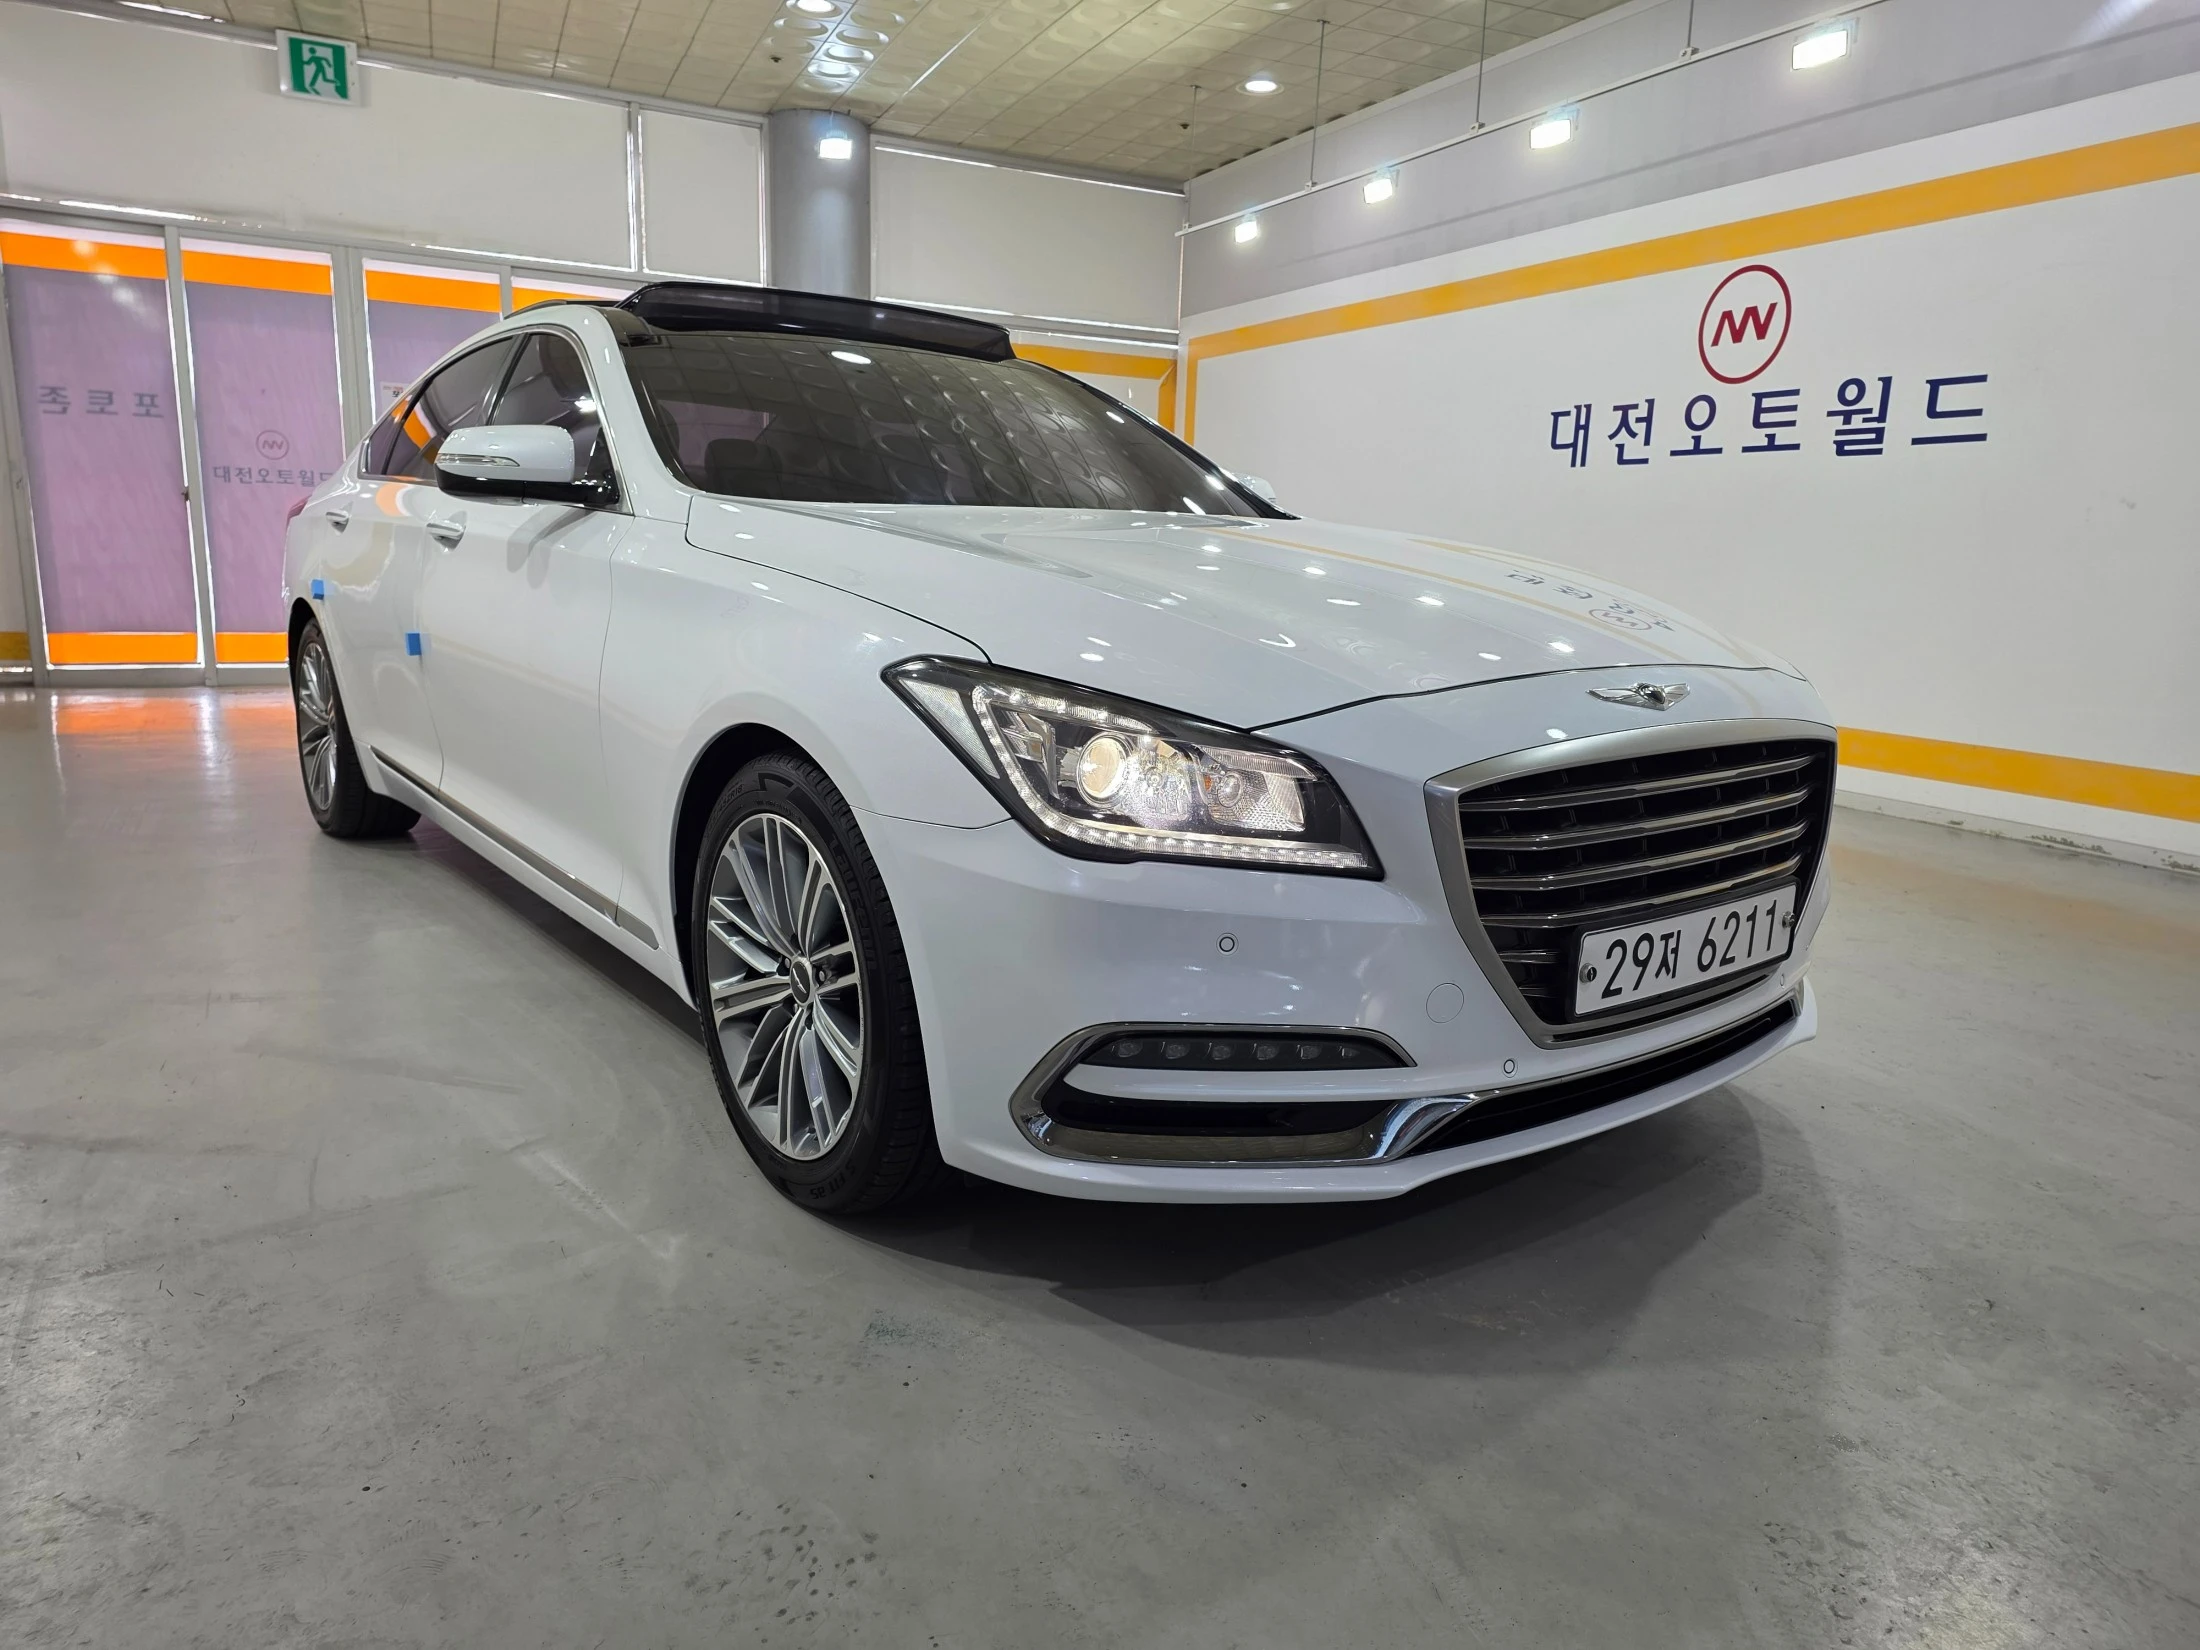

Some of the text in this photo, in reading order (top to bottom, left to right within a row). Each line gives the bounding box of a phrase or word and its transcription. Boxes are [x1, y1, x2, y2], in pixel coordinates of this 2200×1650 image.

[1550, 374, 1989, 467] 대전오토월드
[1601, 899, 1777, 999] 29저 6211
